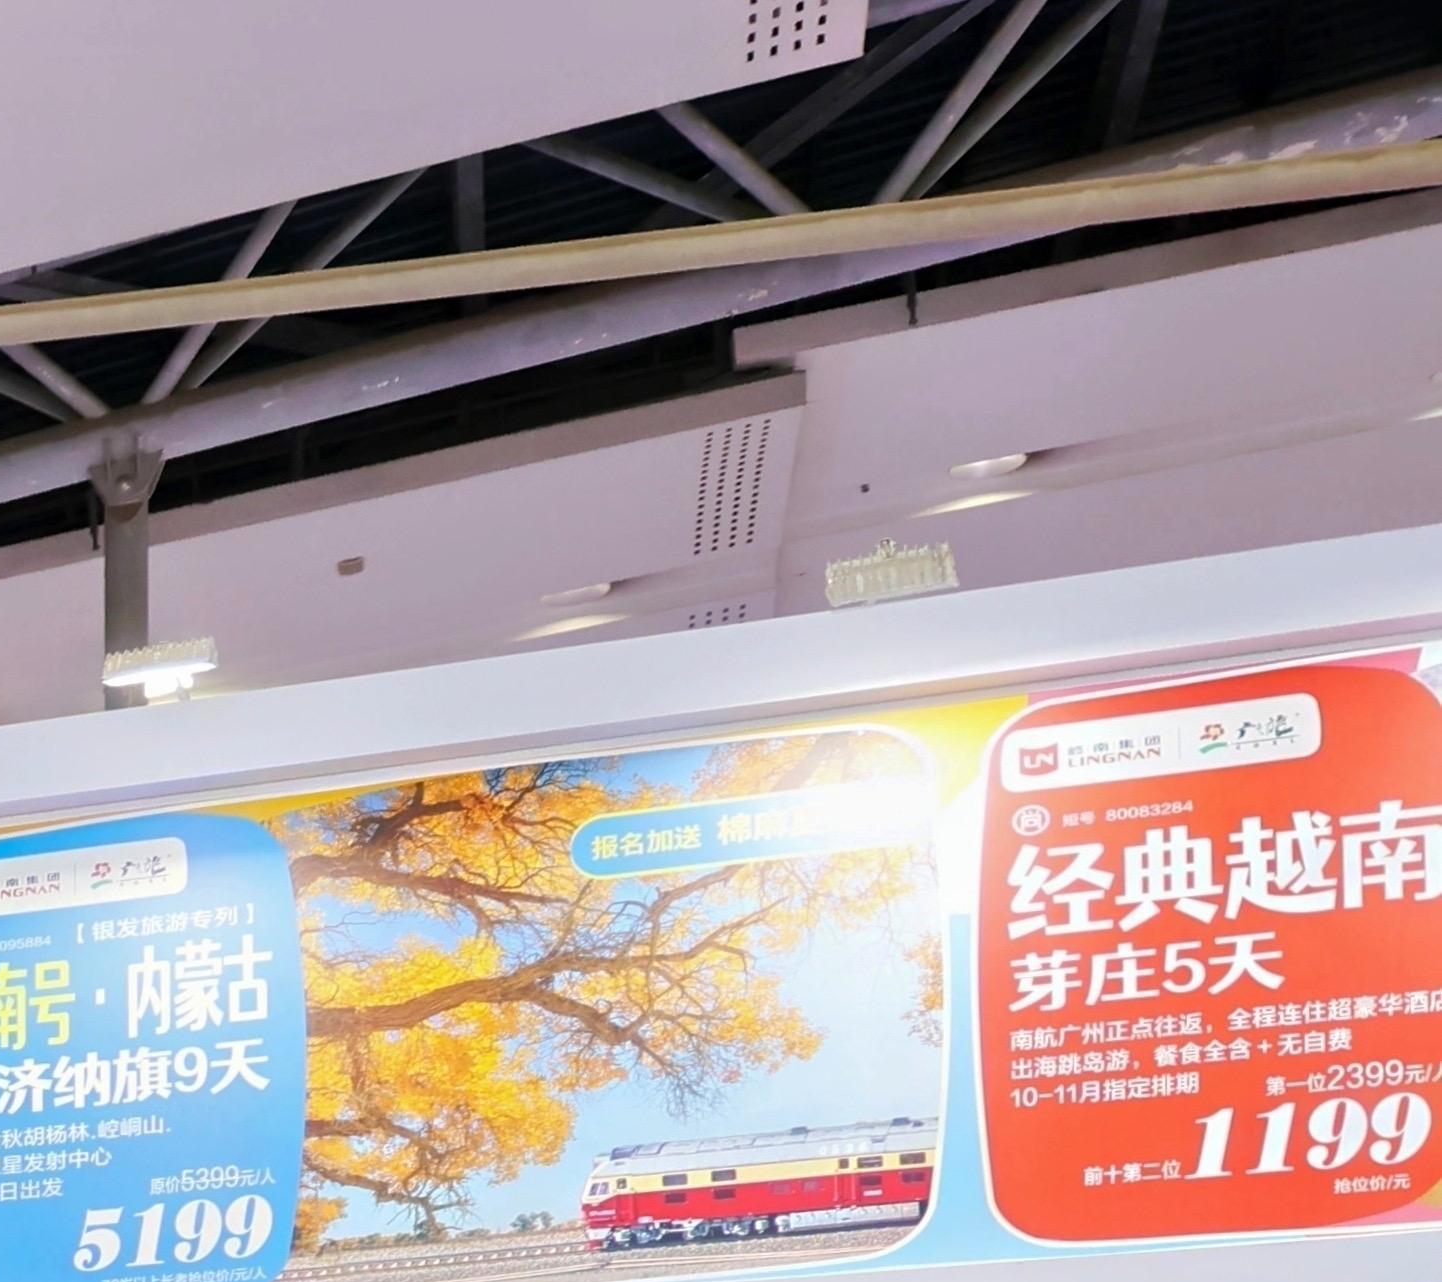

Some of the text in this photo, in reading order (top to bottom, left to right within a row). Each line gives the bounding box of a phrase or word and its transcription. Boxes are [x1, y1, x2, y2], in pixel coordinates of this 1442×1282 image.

[1067, 747, 1162, 769] LINGNAN
[1106, 800, 1194, 823] 80083284
[591, 824, 702, 860] 报名加送
[1006, 800, 1442, 941] 经典越南
[75, 902, 255, 944] 【银发旅游专列】
[1008, 931, 1285, 1013] 芽庄5天
[1184, 1091, 1432, 1182] 1199
[1083, 1159, 1181, 1187] 前十第二位
[73, 1194, 273, 1273] 5199
